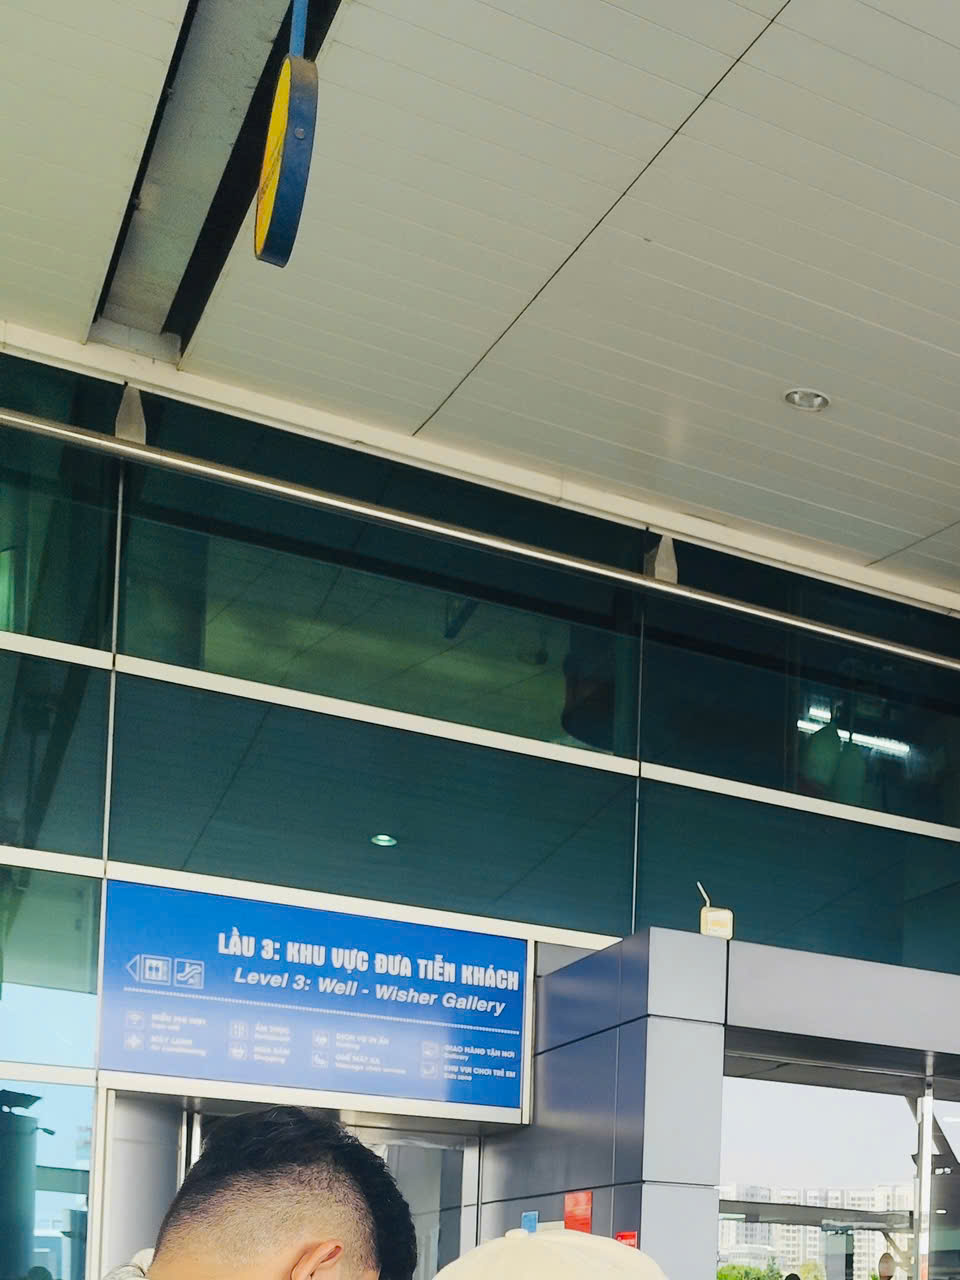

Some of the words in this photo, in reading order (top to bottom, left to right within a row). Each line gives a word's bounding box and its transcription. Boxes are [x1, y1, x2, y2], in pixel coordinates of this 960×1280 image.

[218, 926, 256, 958] LẦU
[261, 938, 280, 961] 3:
[286, 941, 326, 967] KHU
[331, 947, 369, 974] VỰC
[374, 952, 412, 978] ĐƯA
[416, 954, 456, 983] TIỄN
[461, 964, 519, 991] KHÁCH
[234, 966, 289, 988] Level
[292, 974, 312, 991] 3:
[318, 976, 359, 997] Well
[375, 983, 439, 1006] Wisher
[442, 992, 506, 1017] Gallery
